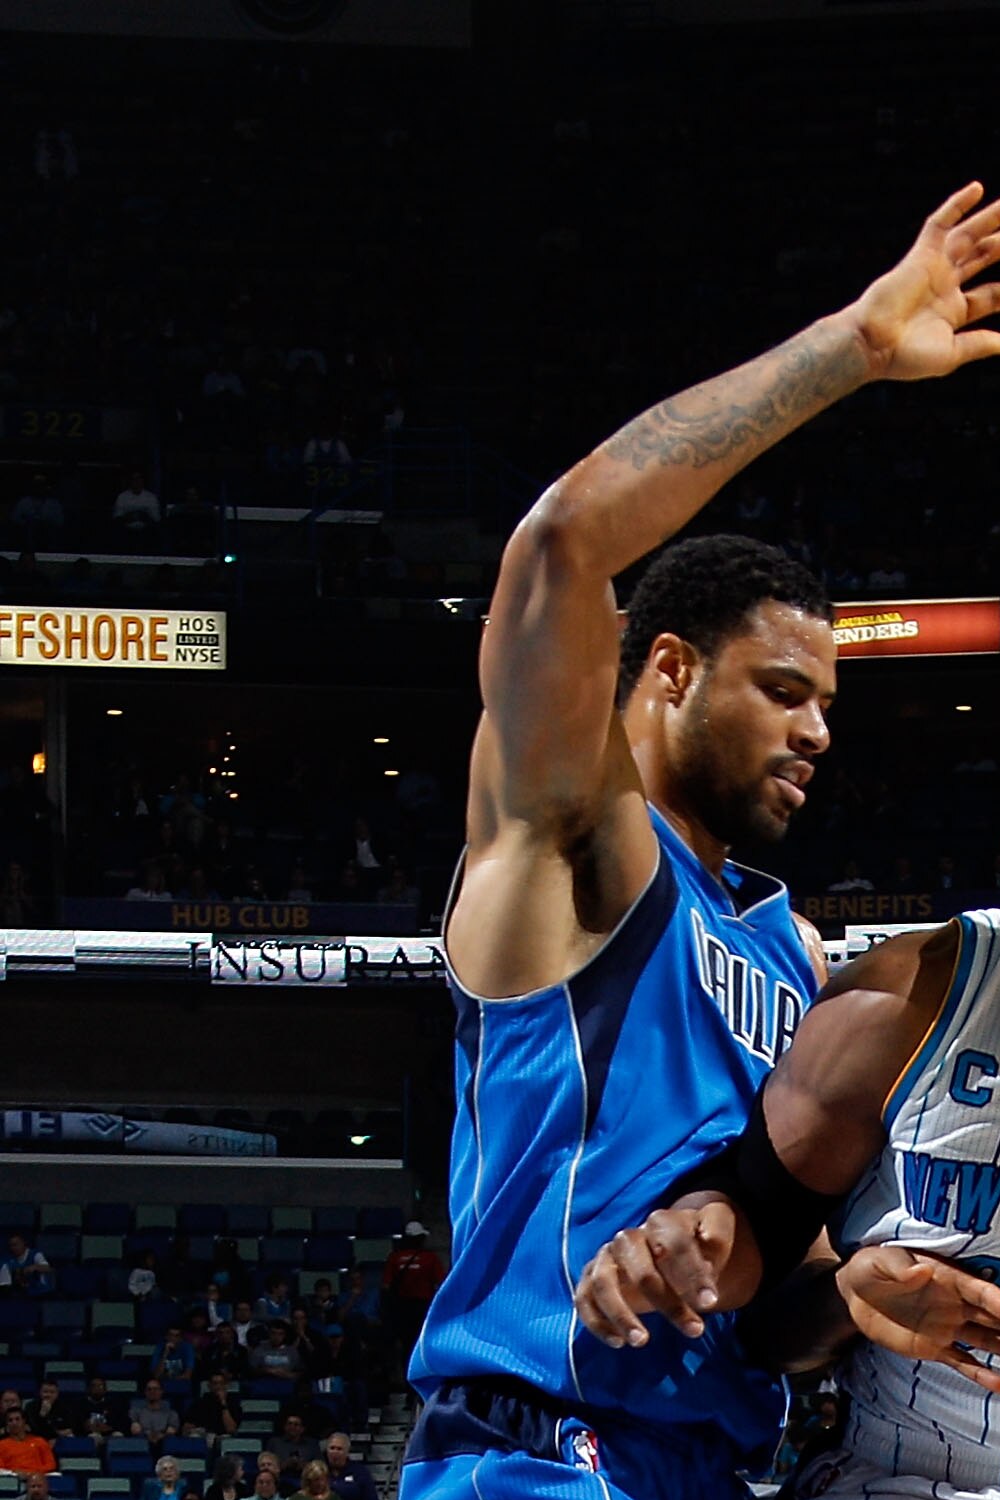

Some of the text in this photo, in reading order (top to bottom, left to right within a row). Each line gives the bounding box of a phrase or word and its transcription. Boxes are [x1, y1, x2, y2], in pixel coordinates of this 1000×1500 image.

[179, 617, 217, 632] HOS
[177, 635, 218, 645] LISTED
[175, 648, 222, 663] NYSE
[172, 903, 311, 929] HUB CLUB
[803, 893, 934, 919] BENEFITS
[949, 1048, 999, 1107] C
